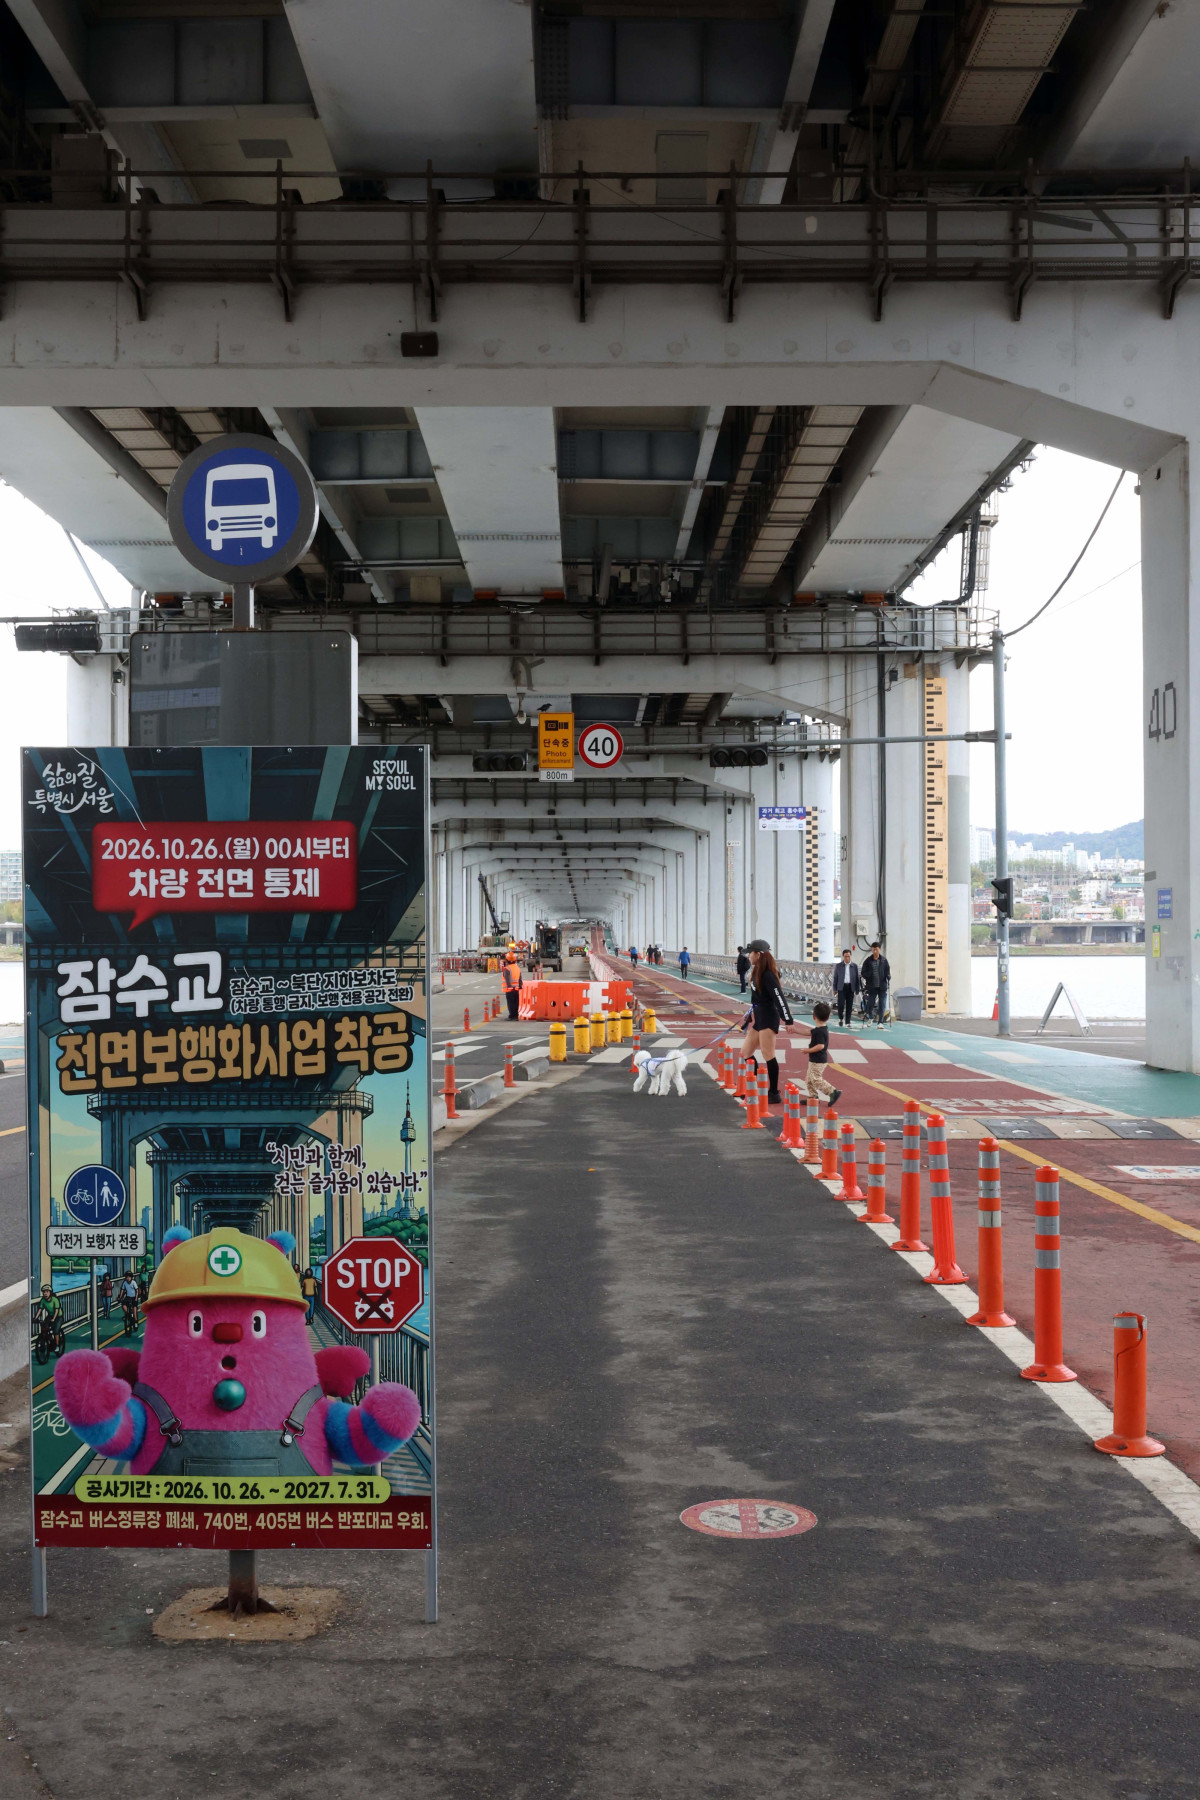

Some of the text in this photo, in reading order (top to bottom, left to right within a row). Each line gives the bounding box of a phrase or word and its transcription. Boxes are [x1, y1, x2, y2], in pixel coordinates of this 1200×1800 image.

[1149, 682, 1177, 742] 40
[543, 738, 569, 748] 단속중
[587, 736, 614, 757] 40
[42, 762, 98, 789] 삶의 질
[386, 775, 417, 791] SOUL
[546, 771, 568, 780] 800m
[28, 787, 115, 814] 특별시 서울
[101, 836, 350, 861] 2026.10.26.(월) 00시부터
[128, 867, 320, 899] 차량 전면 통제
[57, 950, 224, 1024] 잠수교
[230, 976, 275, 997] 잠수교
[291, 973, 322, 992] 북단
[323, 968, 398, 991] 지하보차도
[230, 985, 414, 1015] (차량 통행 금지, 보행 전용 공간 전환)
[57, 1012, 412, 1092] 전면보행화사업 착공
[327, 1143, 367, 1170] 함께,
[275, 1172, 306, 1196] 걷는
[308, 1170, 364, 1196] 즐거움이
[53, 1233, 139, 1250] 자전거 보행자 전용
[336, 1257, 412, 1291] STOP
[212, 1482, 235, 1499] 10.
[239, 1482, 265, 1499] 26.
[356, 1481, 380, 1499] 31.
[40, 1510, 429, 1531] 잠수교 버스정류장 폐쇄, 740번, 405번 버스 반포대교 우회.
